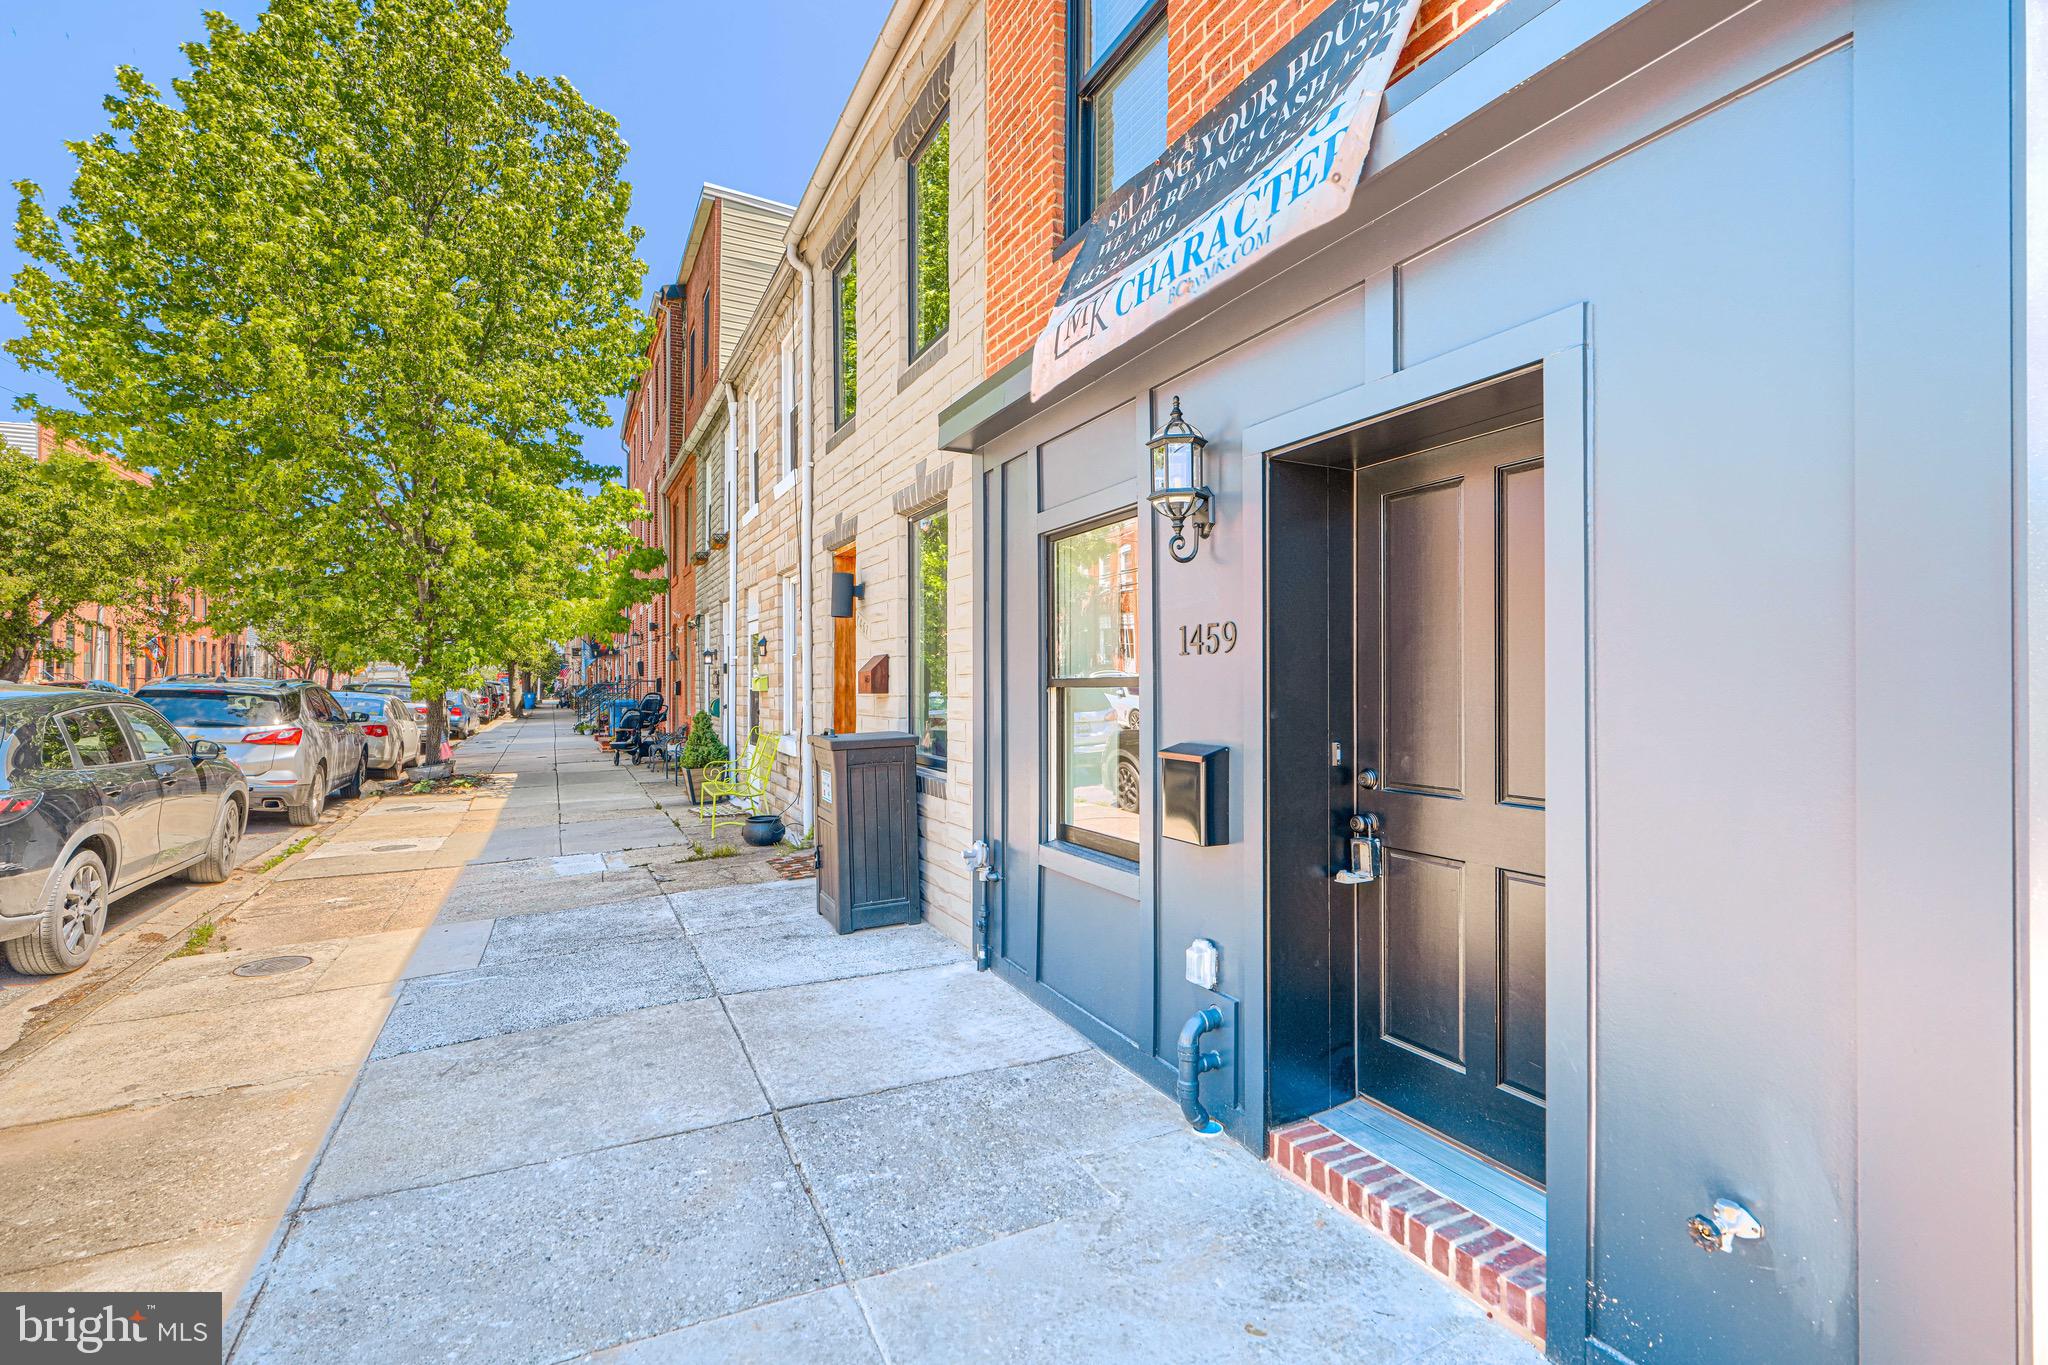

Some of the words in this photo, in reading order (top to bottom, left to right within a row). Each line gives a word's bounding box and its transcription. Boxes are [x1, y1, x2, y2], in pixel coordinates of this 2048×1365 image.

[1105, 149, 1196, 238] SELLING
[1202, 79, 1278, 160] YOUR
[1285, 0, 1390, 95] HOUS
[1099, 231, 1127, 258] WE
[1127, 199, 1161, 241] ARE
[1163, 131, 1255, 211] BUYING!
[1178, 621, 1238, 656] 1459
